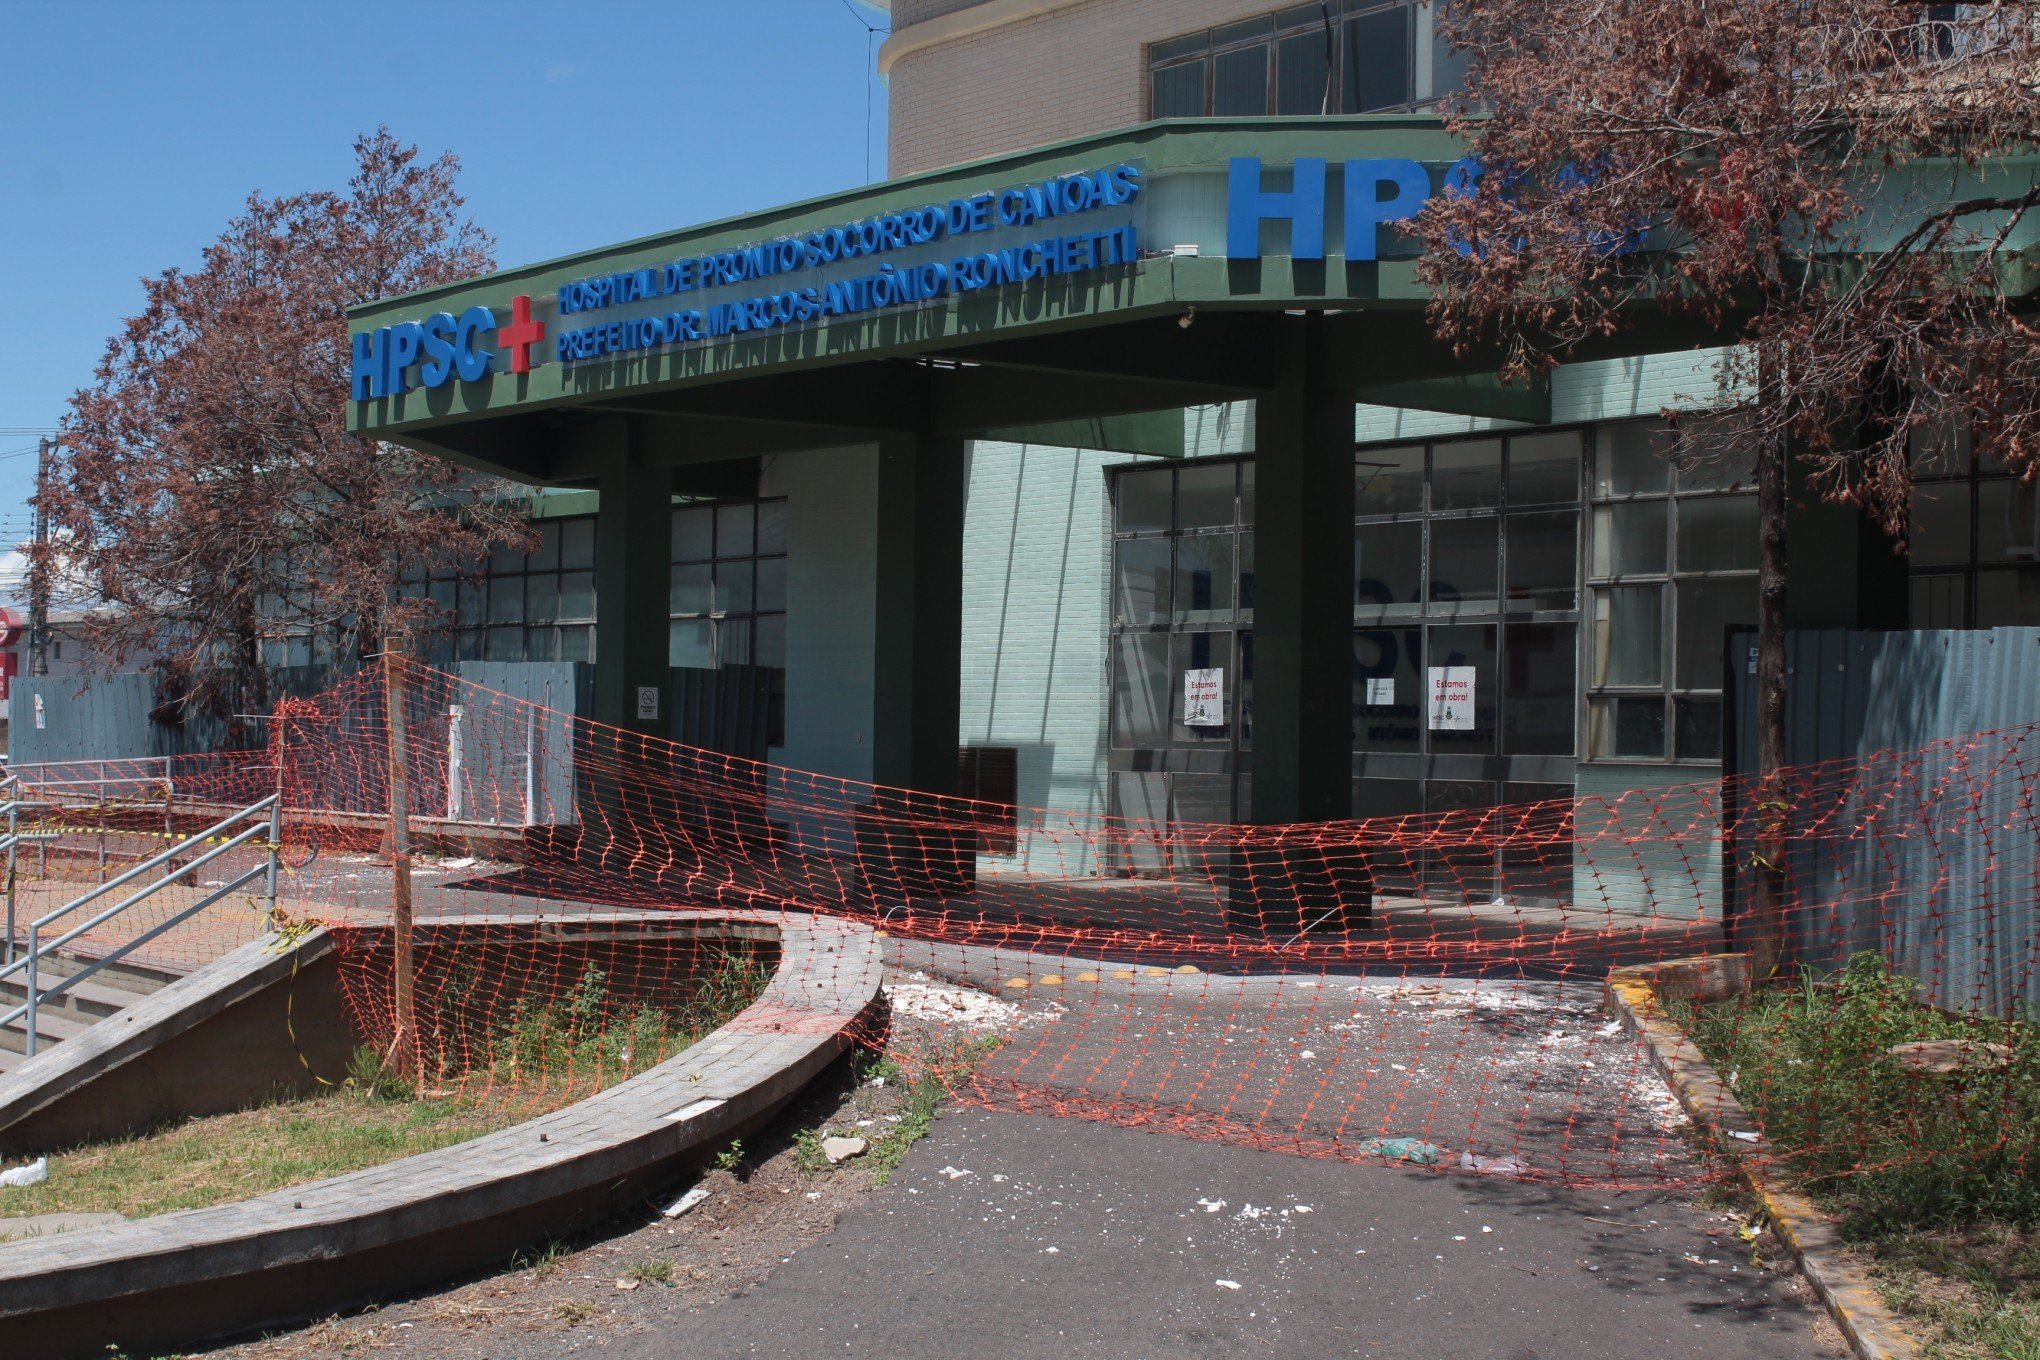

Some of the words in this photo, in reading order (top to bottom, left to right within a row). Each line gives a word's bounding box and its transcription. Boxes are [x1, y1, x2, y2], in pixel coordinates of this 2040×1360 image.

[558, 268, 660, 315] HOSPITAL
[663, 259, 699, 296] DE
[700, 239, 805, 289] PRONTO
[804, 206, 946, 267] SOCORRO
[948, 194, 995, 235] DE
[999, 165, 1139, 226] CANOAS
[557, 317, 663, 361] PREFEITO
[707, 287, 819, 337] MARCOS
[951, 226, 1137, 292] RONCHETTI
[351, 306, 496, 400] HPSC
[1191, 681, 1217, 689] Estamos
[1436, 680, 1467, 688] Estamos
[1201, 692, 1218, 700] obra!
[1448, 693, 1468, 701] obra!
